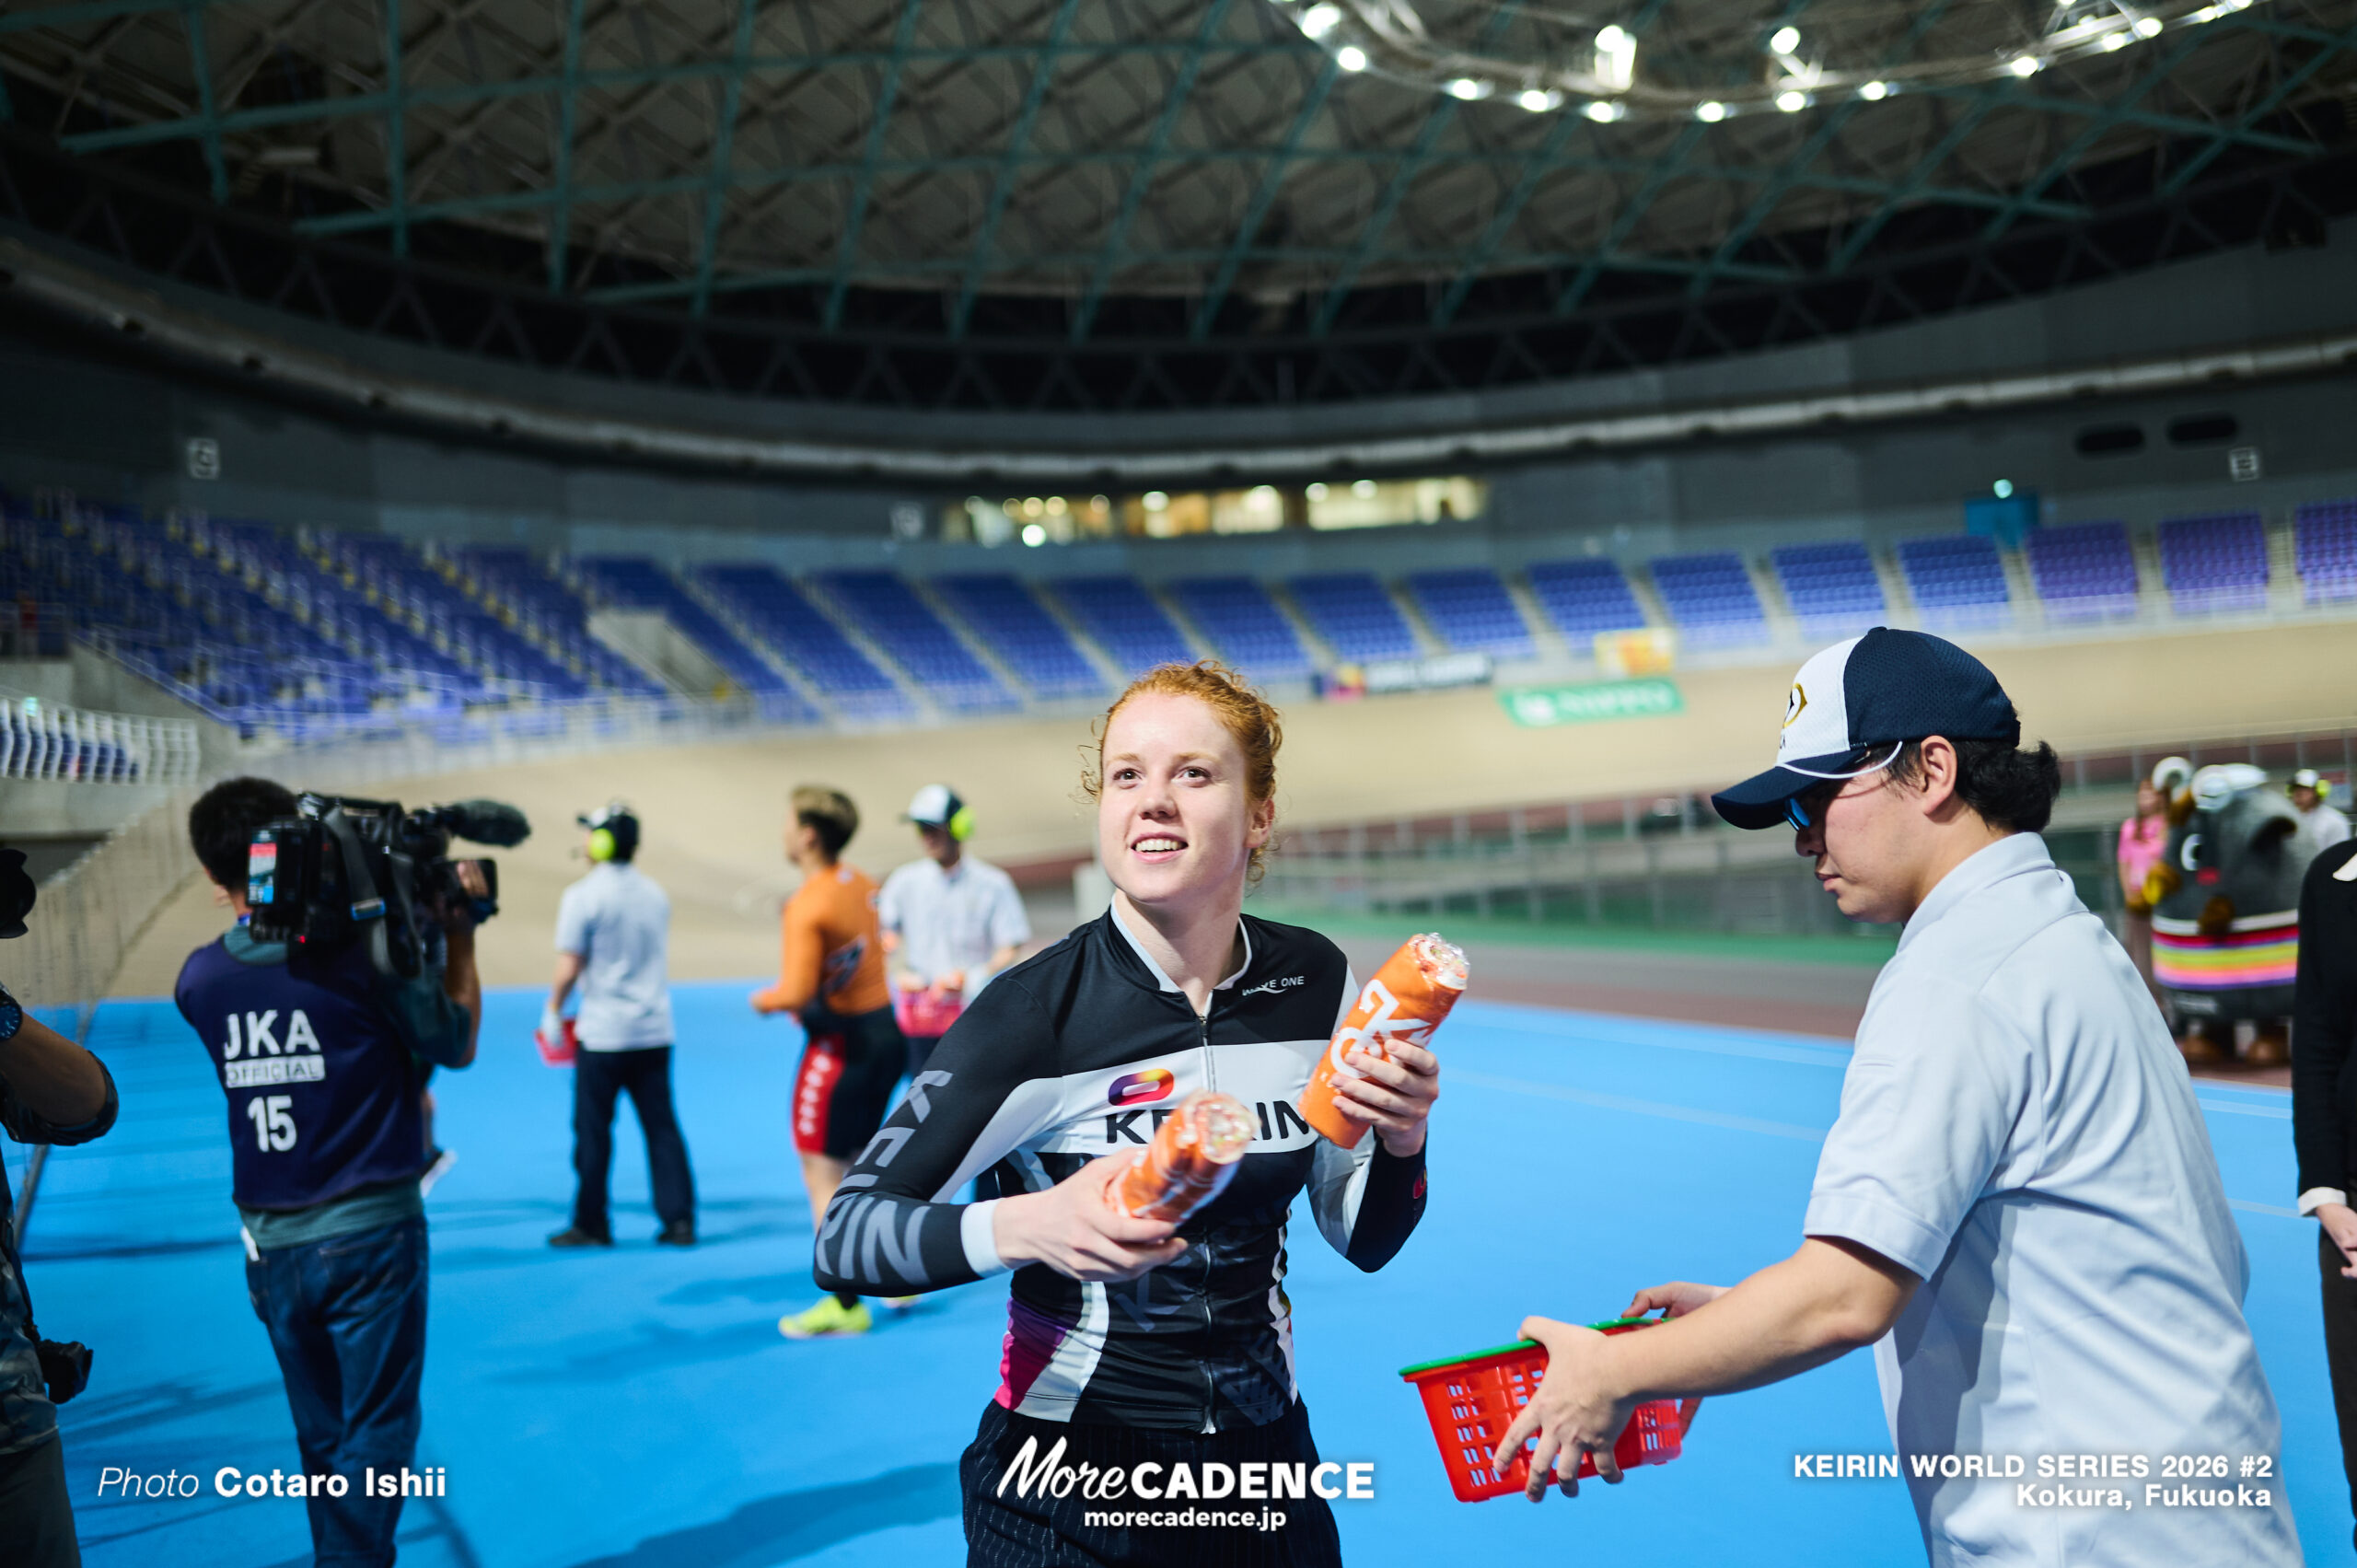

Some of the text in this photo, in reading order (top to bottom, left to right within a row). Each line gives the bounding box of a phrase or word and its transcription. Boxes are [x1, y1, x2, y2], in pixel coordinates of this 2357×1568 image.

[1281, 976, 1305, 987] ONE
[224, 1009, 321, 1060] JKA
[226, 1061, 319, 1086] OFFICIAL
[248, 1095, 297, 1153] 15
